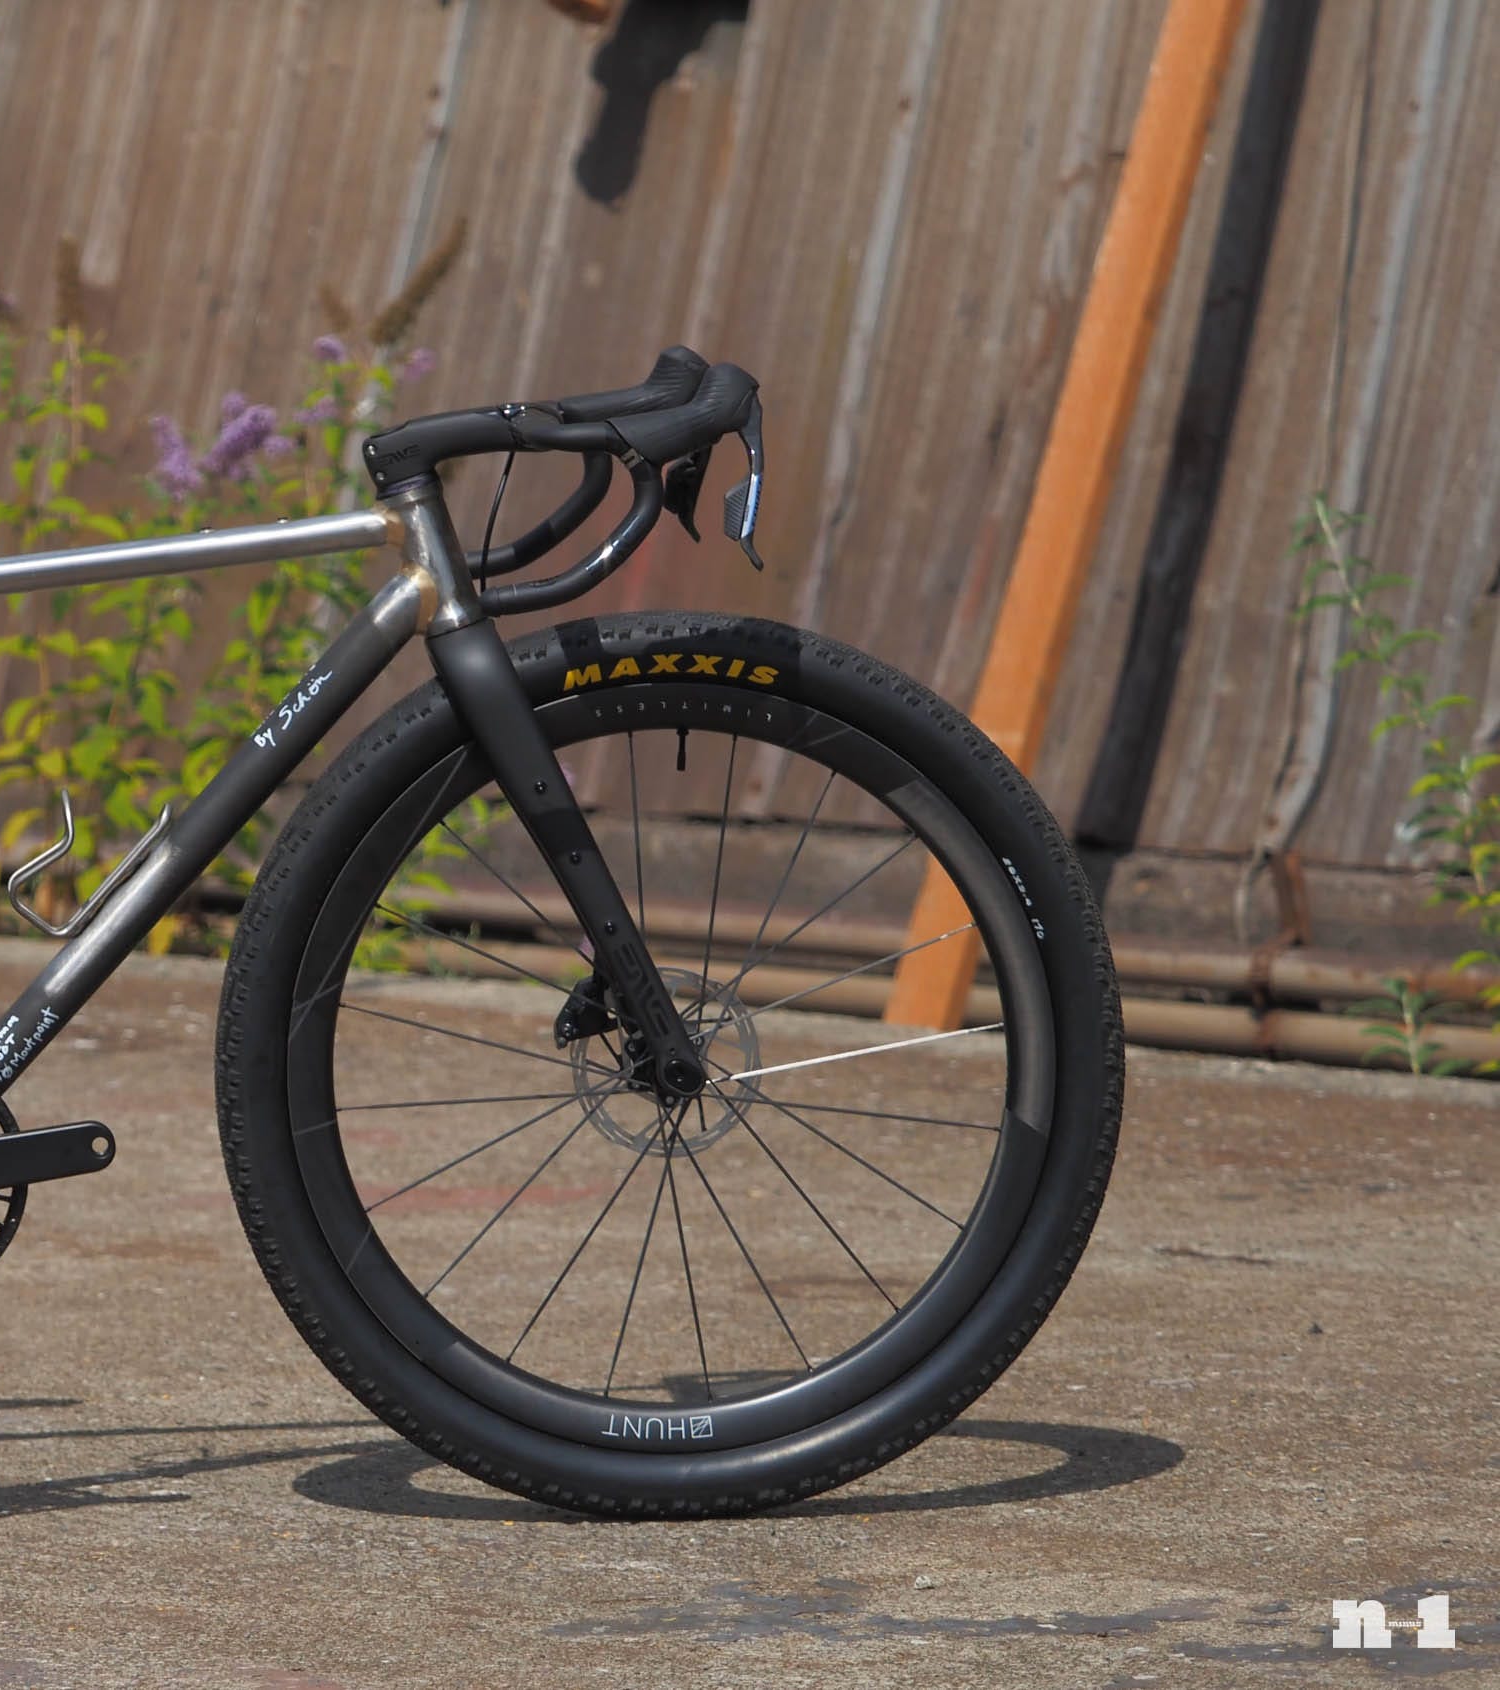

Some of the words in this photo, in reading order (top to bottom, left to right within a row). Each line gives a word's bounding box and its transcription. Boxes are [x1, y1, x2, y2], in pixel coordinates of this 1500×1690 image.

[563, 653, 780, 692] MAXXIS
[278, 670, 333, 730] Schön
[595, 700, 772, 722] LIMITLESS
[601, 1413, 686, 1440] HUNT
